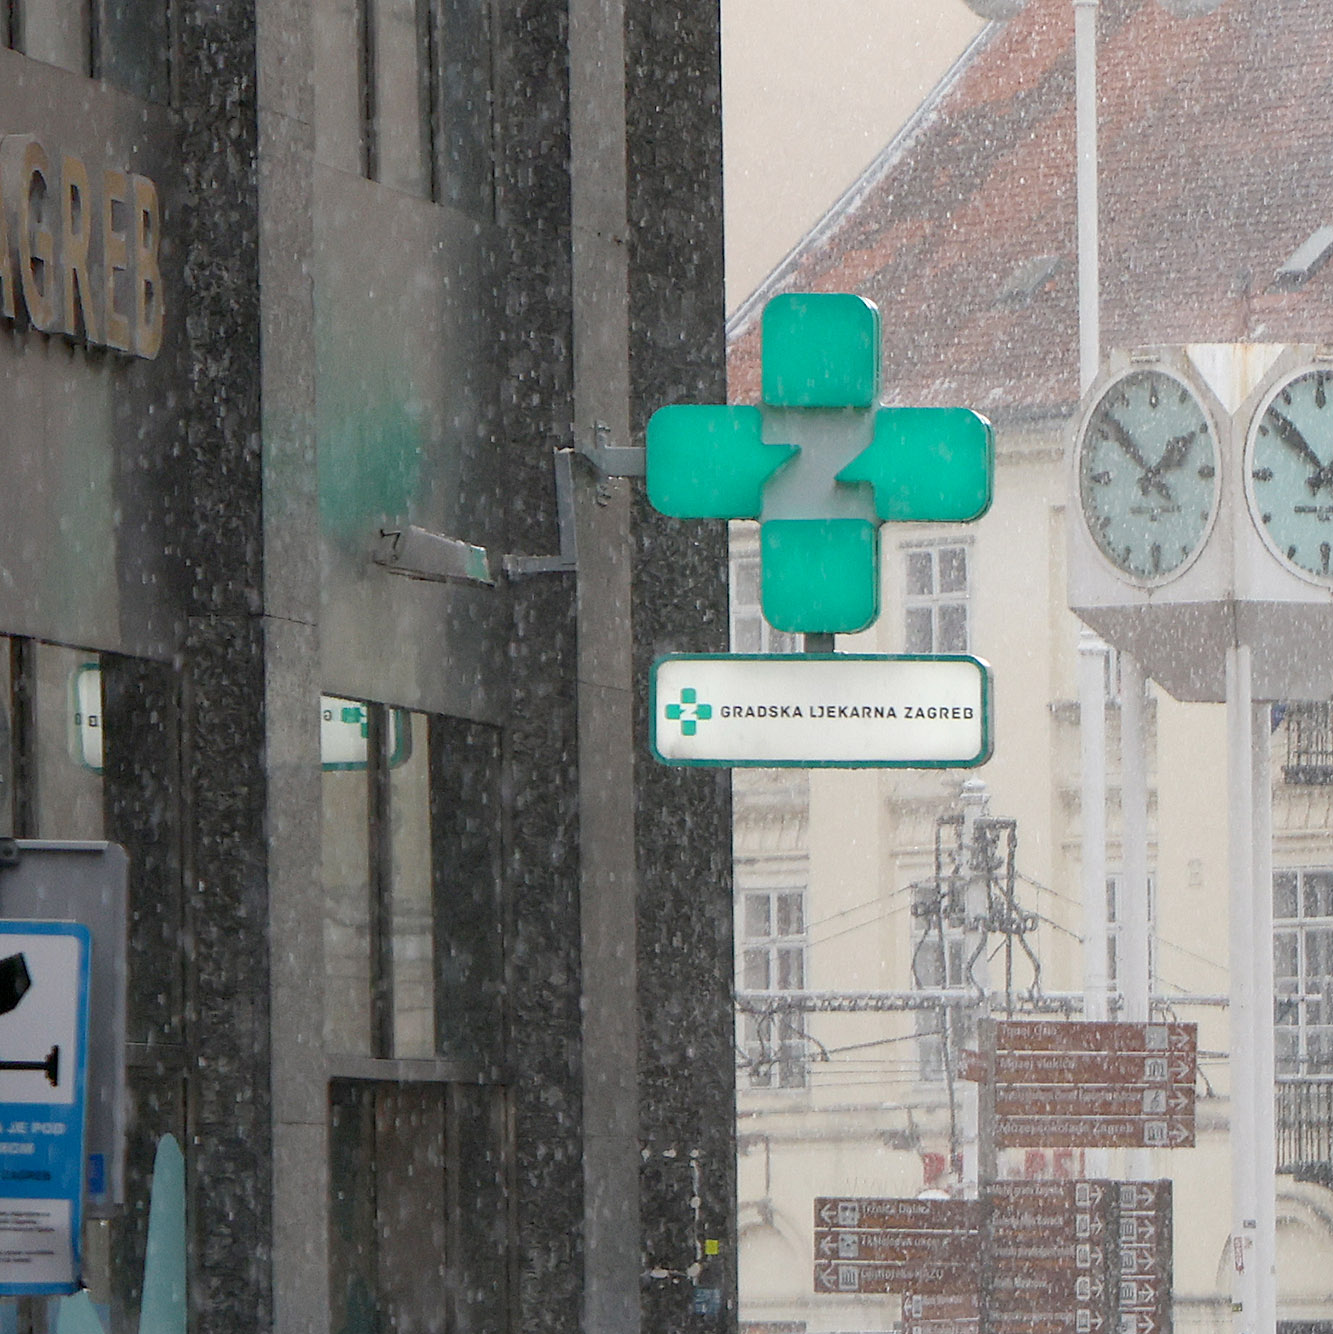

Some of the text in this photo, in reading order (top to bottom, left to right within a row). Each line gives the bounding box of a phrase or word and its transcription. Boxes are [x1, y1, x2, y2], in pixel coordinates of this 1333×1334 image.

[720, 705, 974, 720] GRADSKA LJEKARNA ZAGREB
